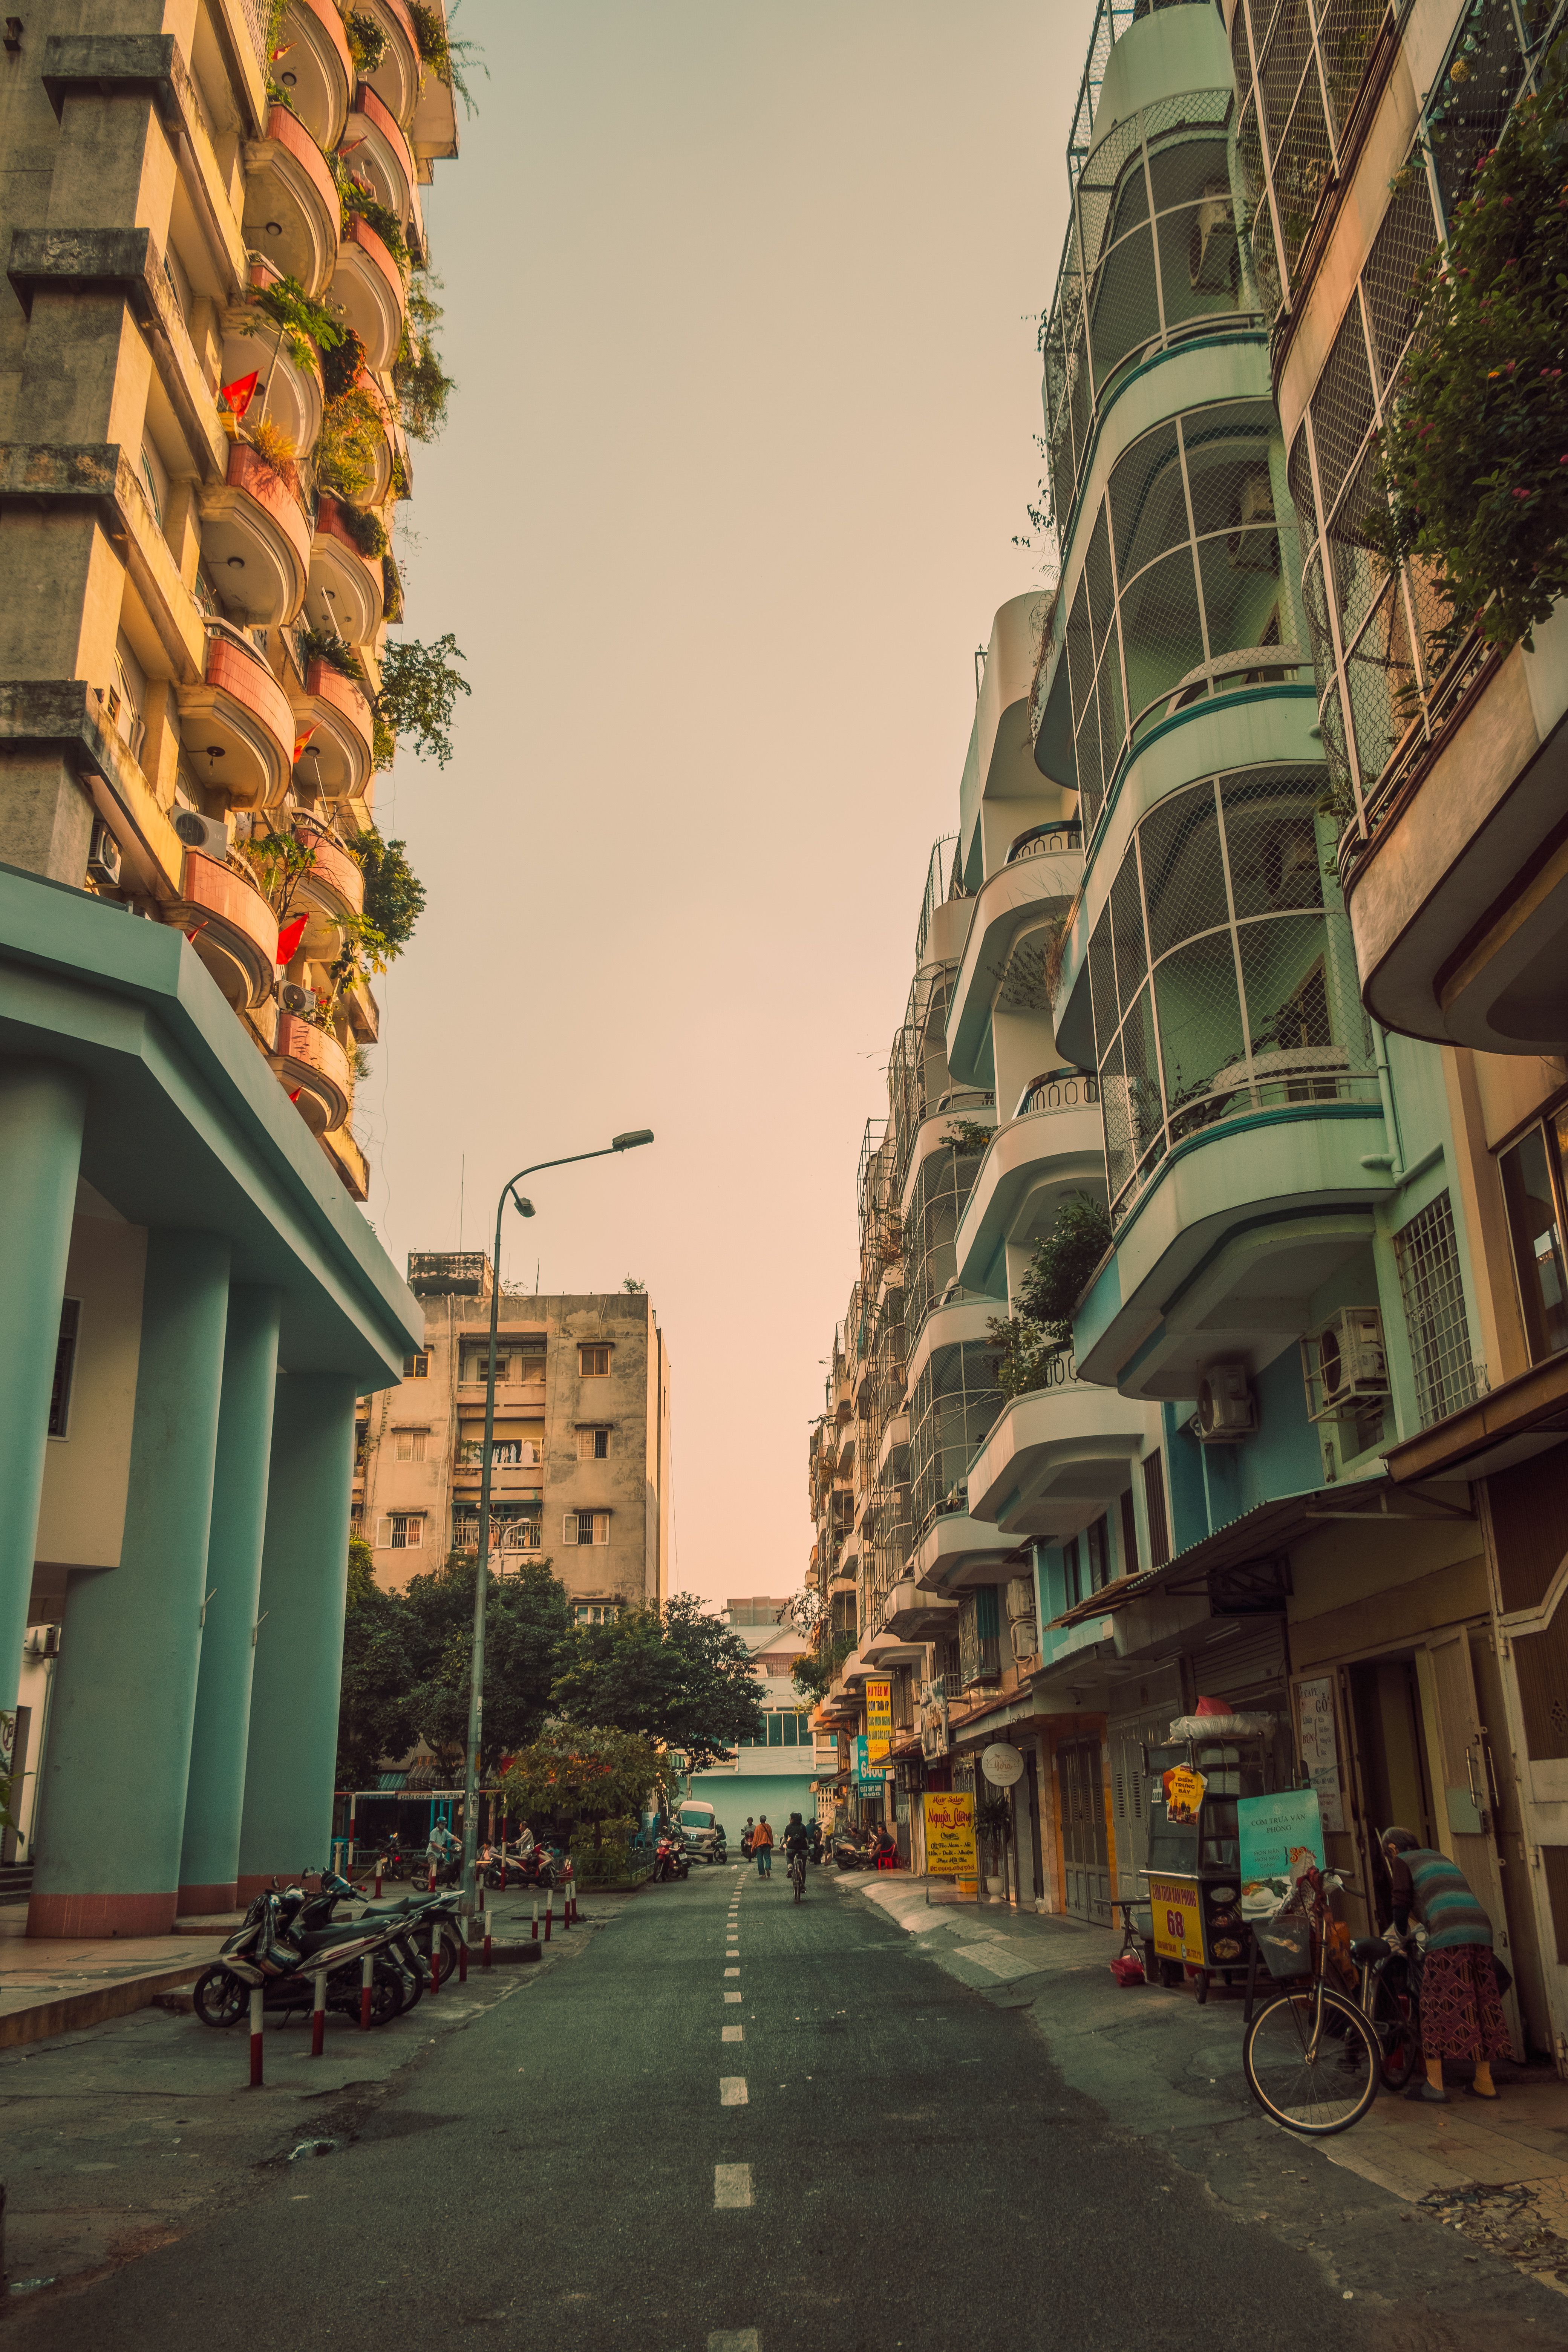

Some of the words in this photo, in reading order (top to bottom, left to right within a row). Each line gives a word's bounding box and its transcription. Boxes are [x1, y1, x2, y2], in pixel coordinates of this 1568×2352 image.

[874, 1683, 882, 1696] TIẾU
[1304, 1687, 1318, 1698] CAFE
[885, 1701, 889, 1711] VP
[1315, 1692, 1328, 1713] GỖ
[933, 1795, 946, 1805] Hair
[948, 1796, 964, 1805] Salon
[928, 1807, 955, 1829] Nguyễn
[1269, 1816, 1288, 1824] TRƯA
[1266, 1825, 1291, 1833] PHÒNG
[1152, 1883, 1161, 1900] CƠM
[1161, 1886, 1172, 1903] TRƯA
[1181, 1886, 1197, 1908] PHÒNG
[1167, 1909, 1185, 1939] 68
